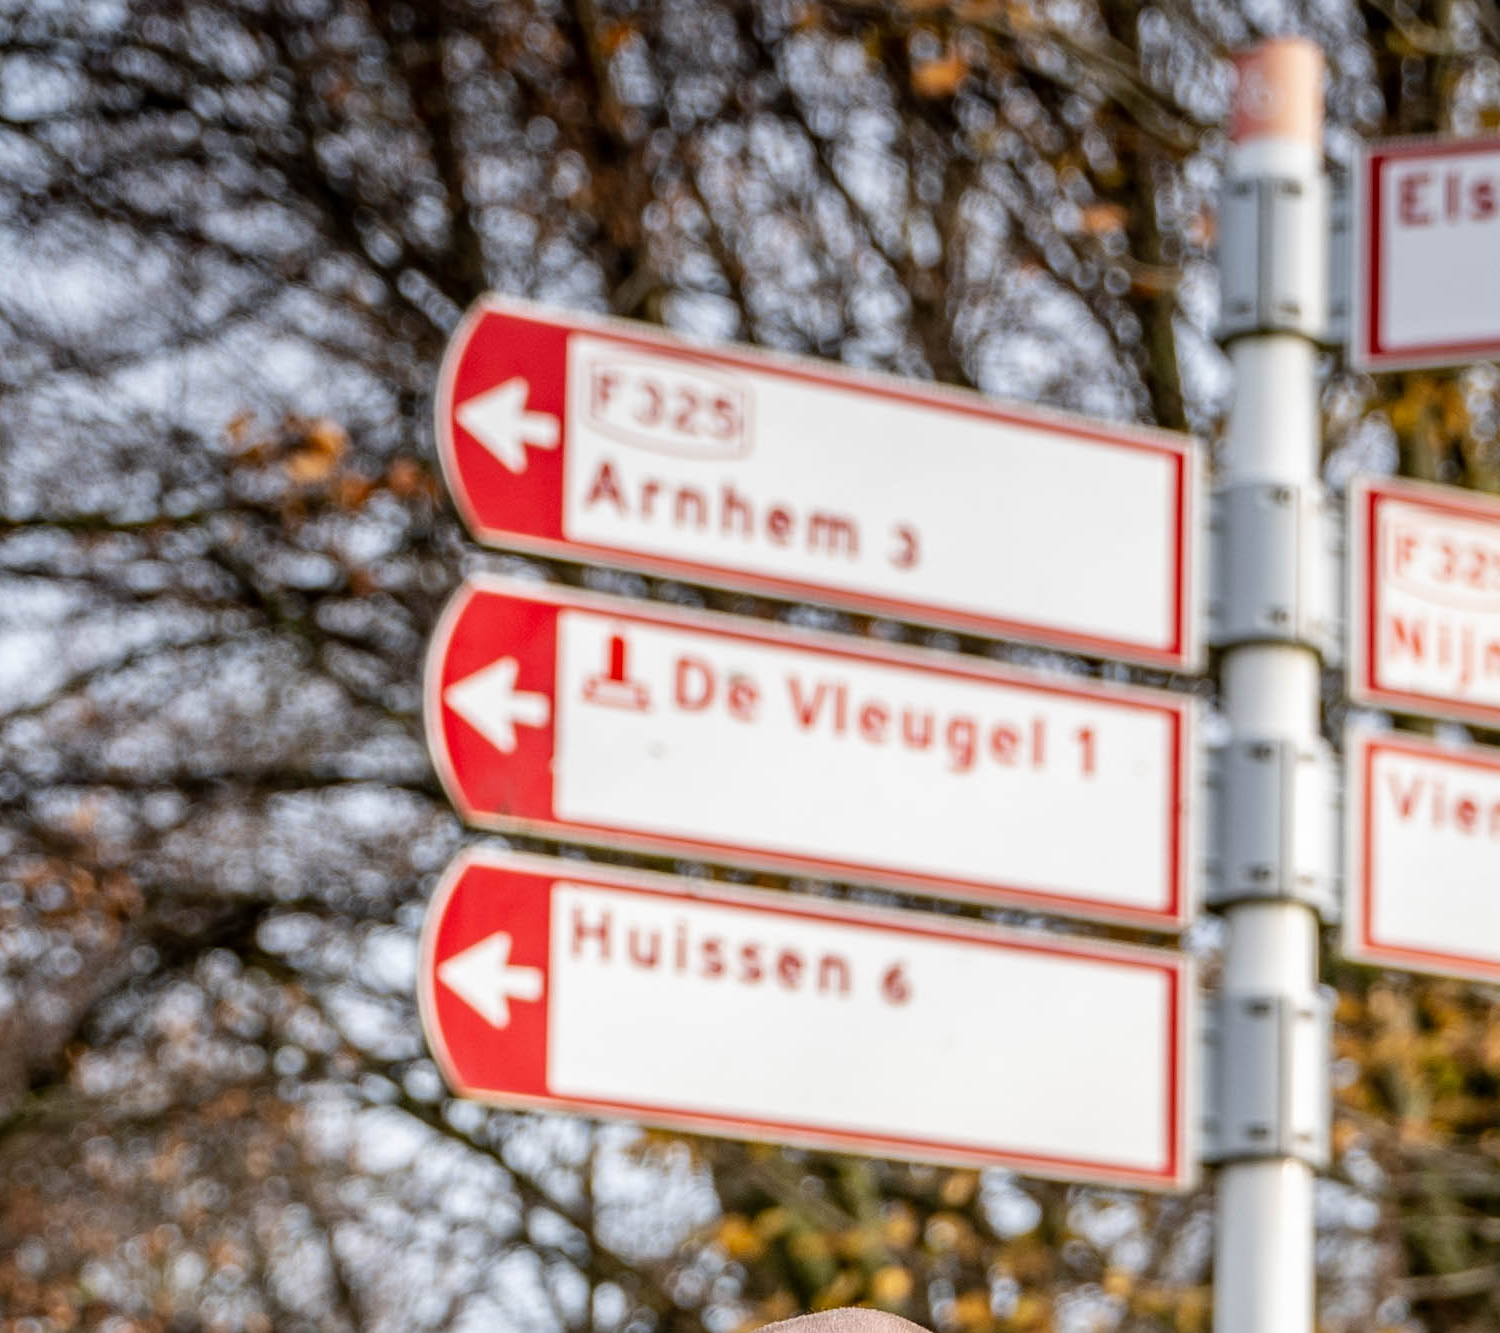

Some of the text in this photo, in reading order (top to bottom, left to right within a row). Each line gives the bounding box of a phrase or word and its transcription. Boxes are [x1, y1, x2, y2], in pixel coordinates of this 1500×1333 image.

[583, 458, 921, 570] Arnhem 3
[672, 654, 1098, 776] De Vleugel 1
[572, 905, 913, 1007] Huissen 6
